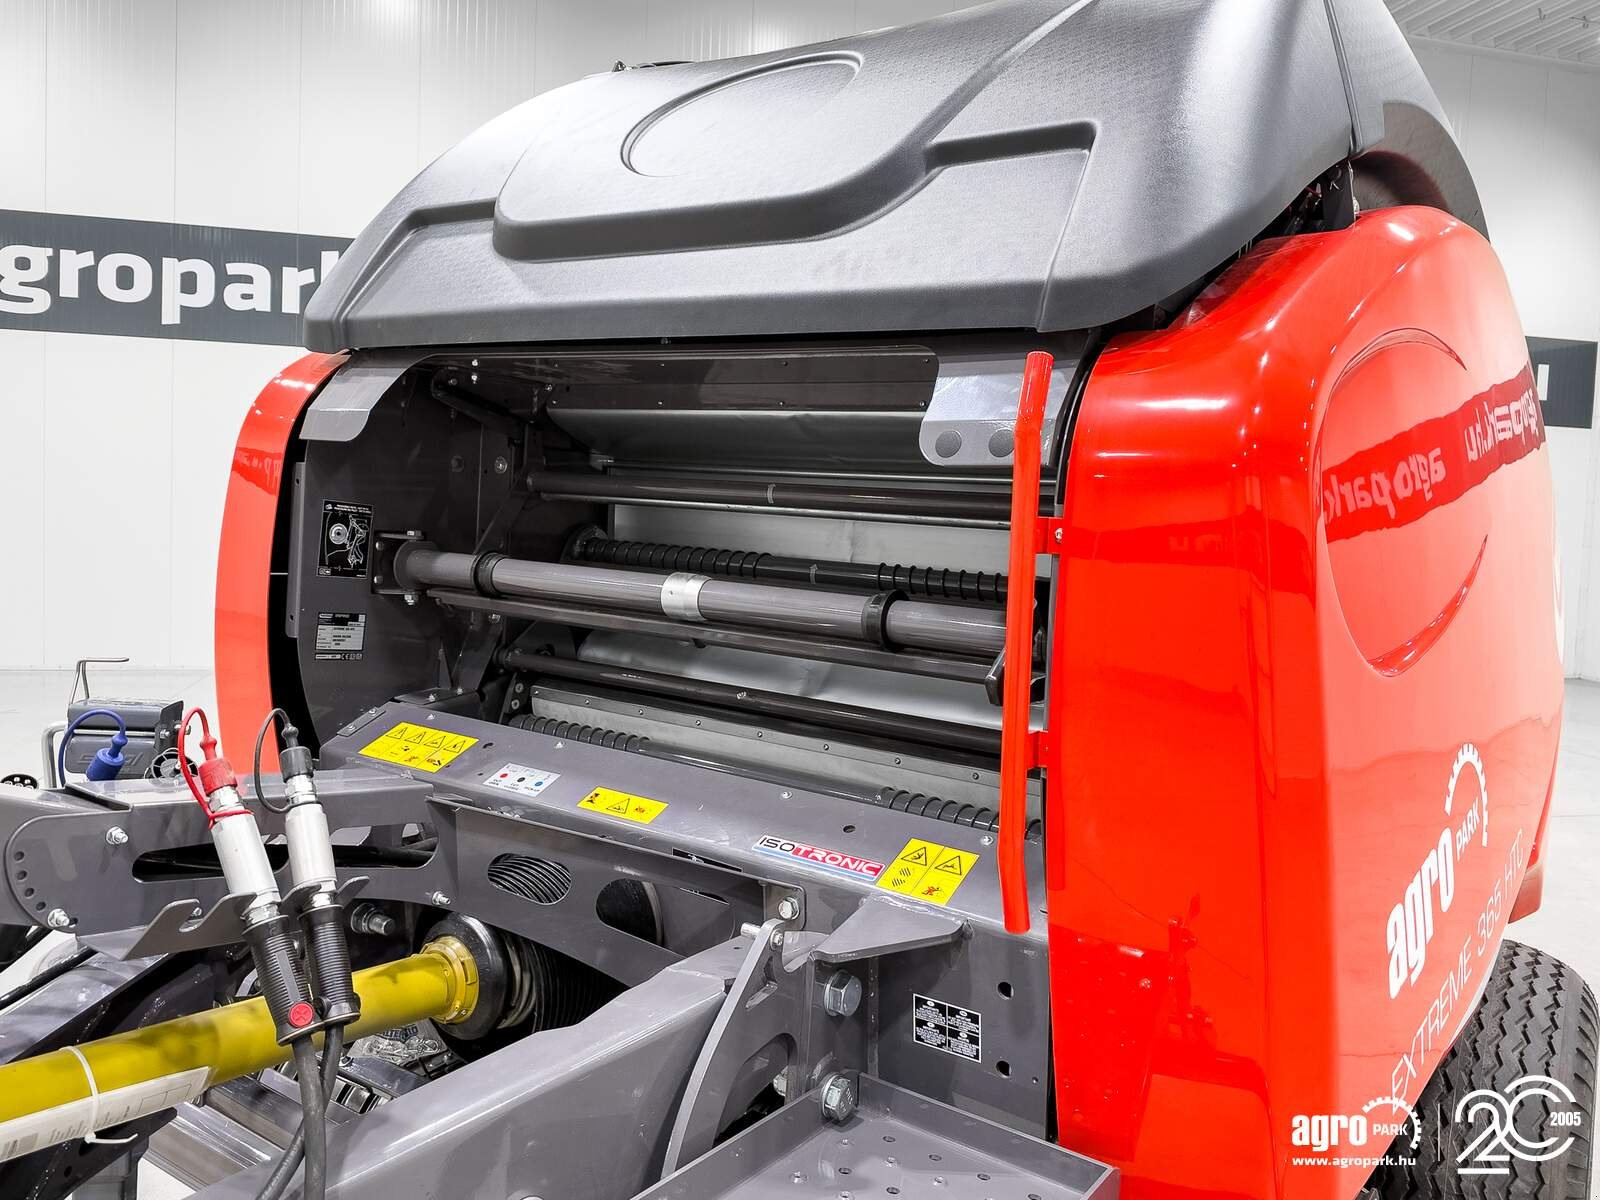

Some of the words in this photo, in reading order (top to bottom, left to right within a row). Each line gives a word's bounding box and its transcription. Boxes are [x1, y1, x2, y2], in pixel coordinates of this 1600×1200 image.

[758, 836, 882, 876] ISOTRONIC
[1386, 827, 1455, 999] agro
[1455, 797, 1481, 862] PARK
[1391, 934, 1473, 1115] EXTREME
[1476, 878, 1503, 958] 365
[1503, 828, 1524, 897] HTC
